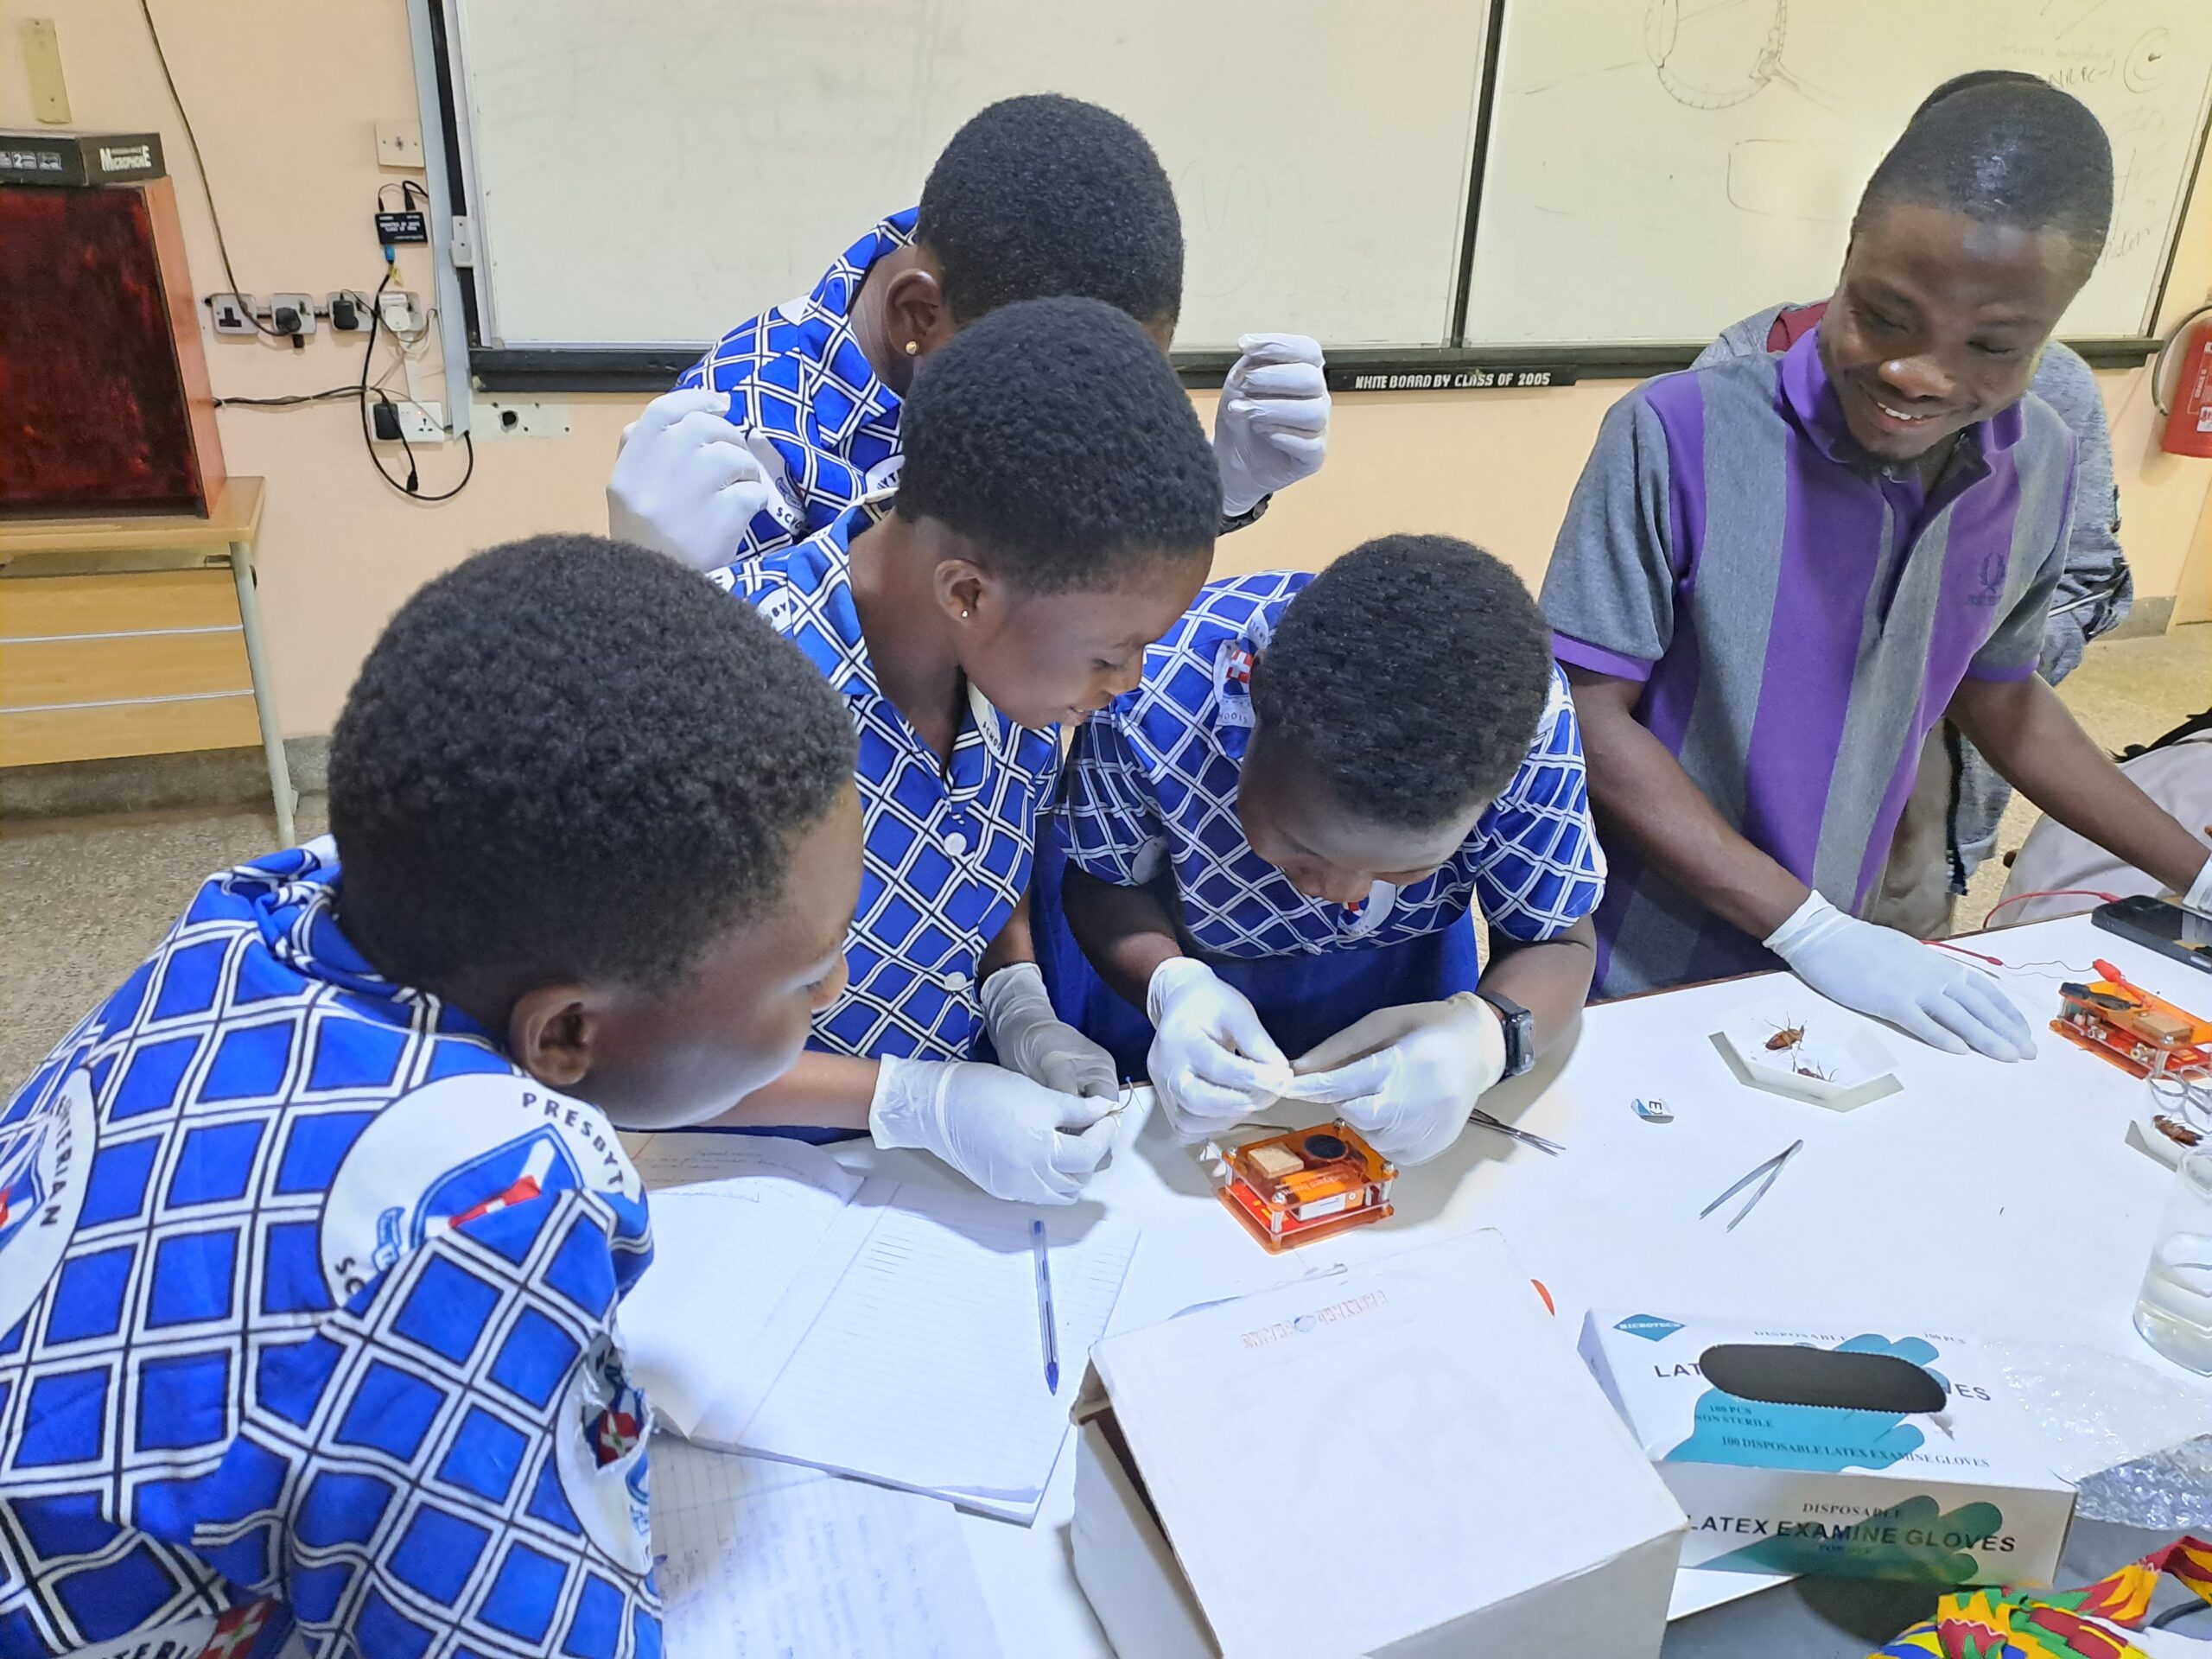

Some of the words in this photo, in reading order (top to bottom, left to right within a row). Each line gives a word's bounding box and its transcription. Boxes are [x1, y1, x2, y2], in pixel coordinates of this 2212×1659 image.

[1355, 375, 1389, 389] WHITE
[1389, 374, 1433, 388] BOARD
[1433, 374, 1452, 387] BY
[1454, 373, 1494, 387] CLASS
[1497, 373, 1514, 386] OF
[1518, 372, 1552, 385] 2005
[1721, 1414, 1774, 1428] STERILE
[1721, 1436, 1740, 1447] 100
[1742, 1439, 1823, 1455] DISPOSABLE
[1826, 1446, 1869, 1459] LATEX
[1869, 1449, 1934, 1465] EXAMINE
[1936, 1454, 1990, 1469] GLOVES
[1777, 1521, 1897, 1545] EXAMINE
[1904, 1529, 2017, 1553] GLOVES
